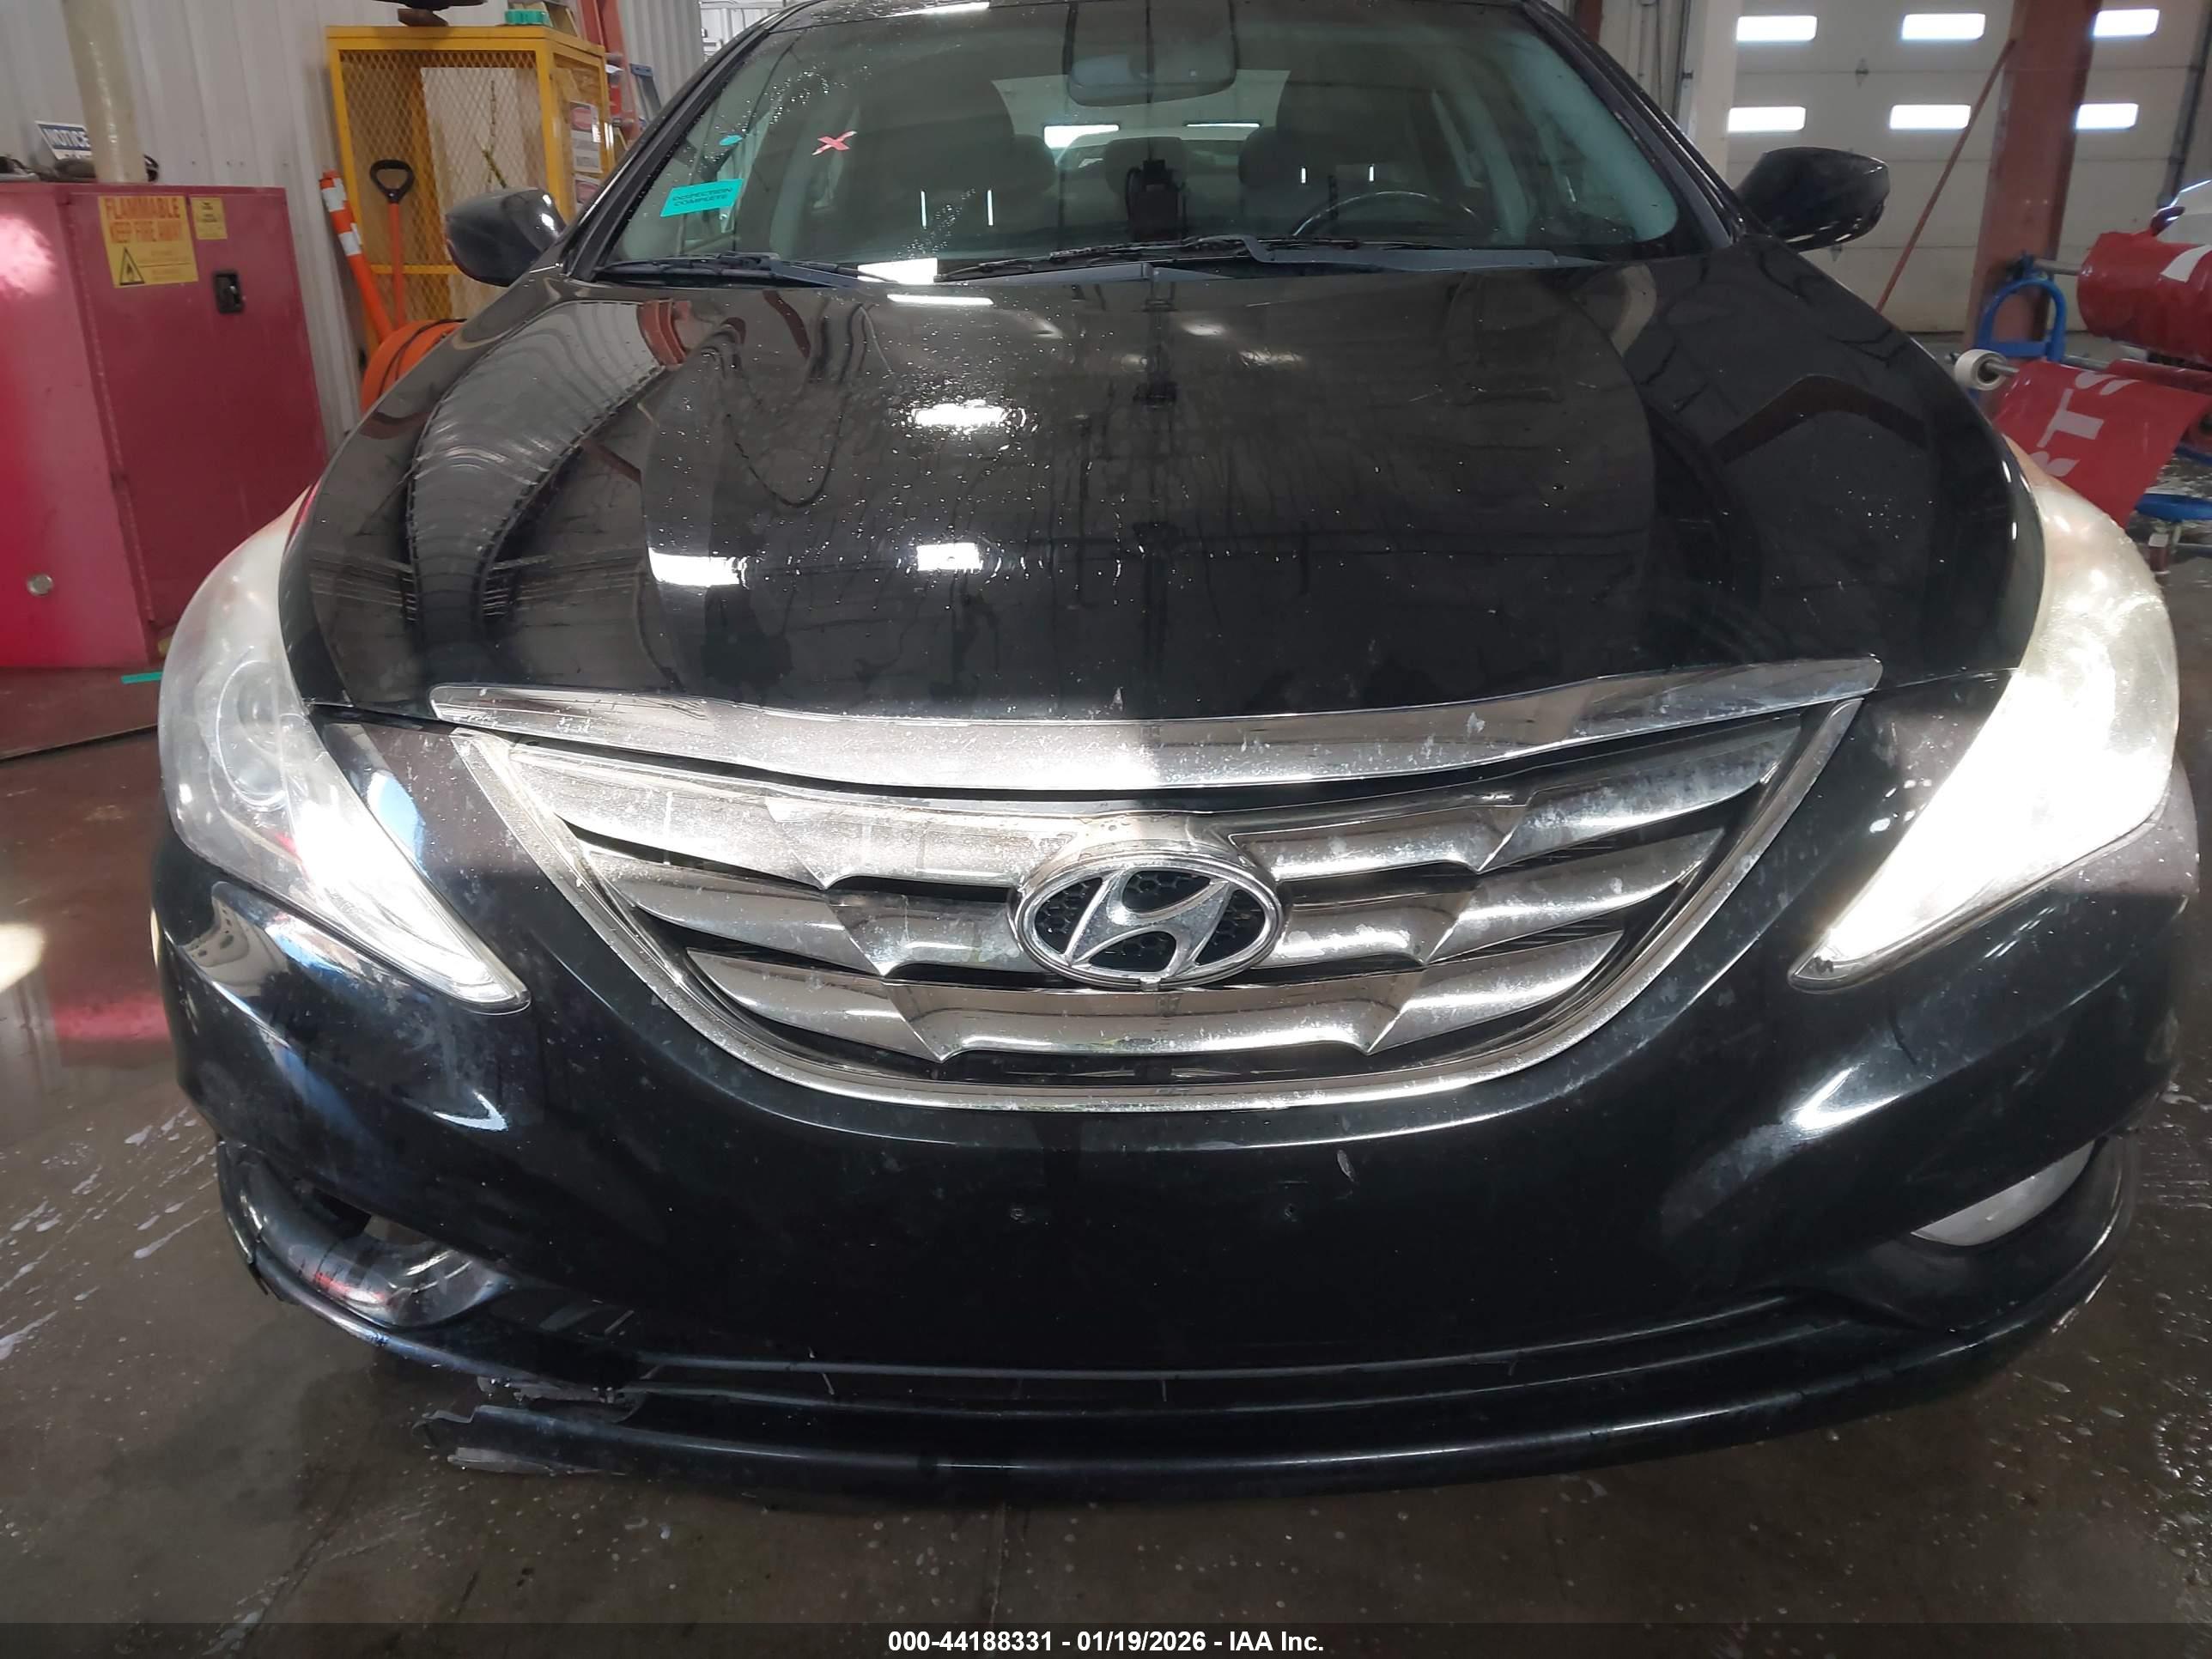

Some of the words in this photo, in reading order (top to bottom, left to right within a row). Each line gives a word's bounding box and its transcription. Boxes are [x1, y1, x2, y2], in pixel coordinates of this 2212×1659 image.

[41, 128, 91, 148] NOTICE
[104, 198, 181, 220] FLAMMABLE
[110, 221, 131, 243] KEEP
[133, 220, 157, 243] FIRE
